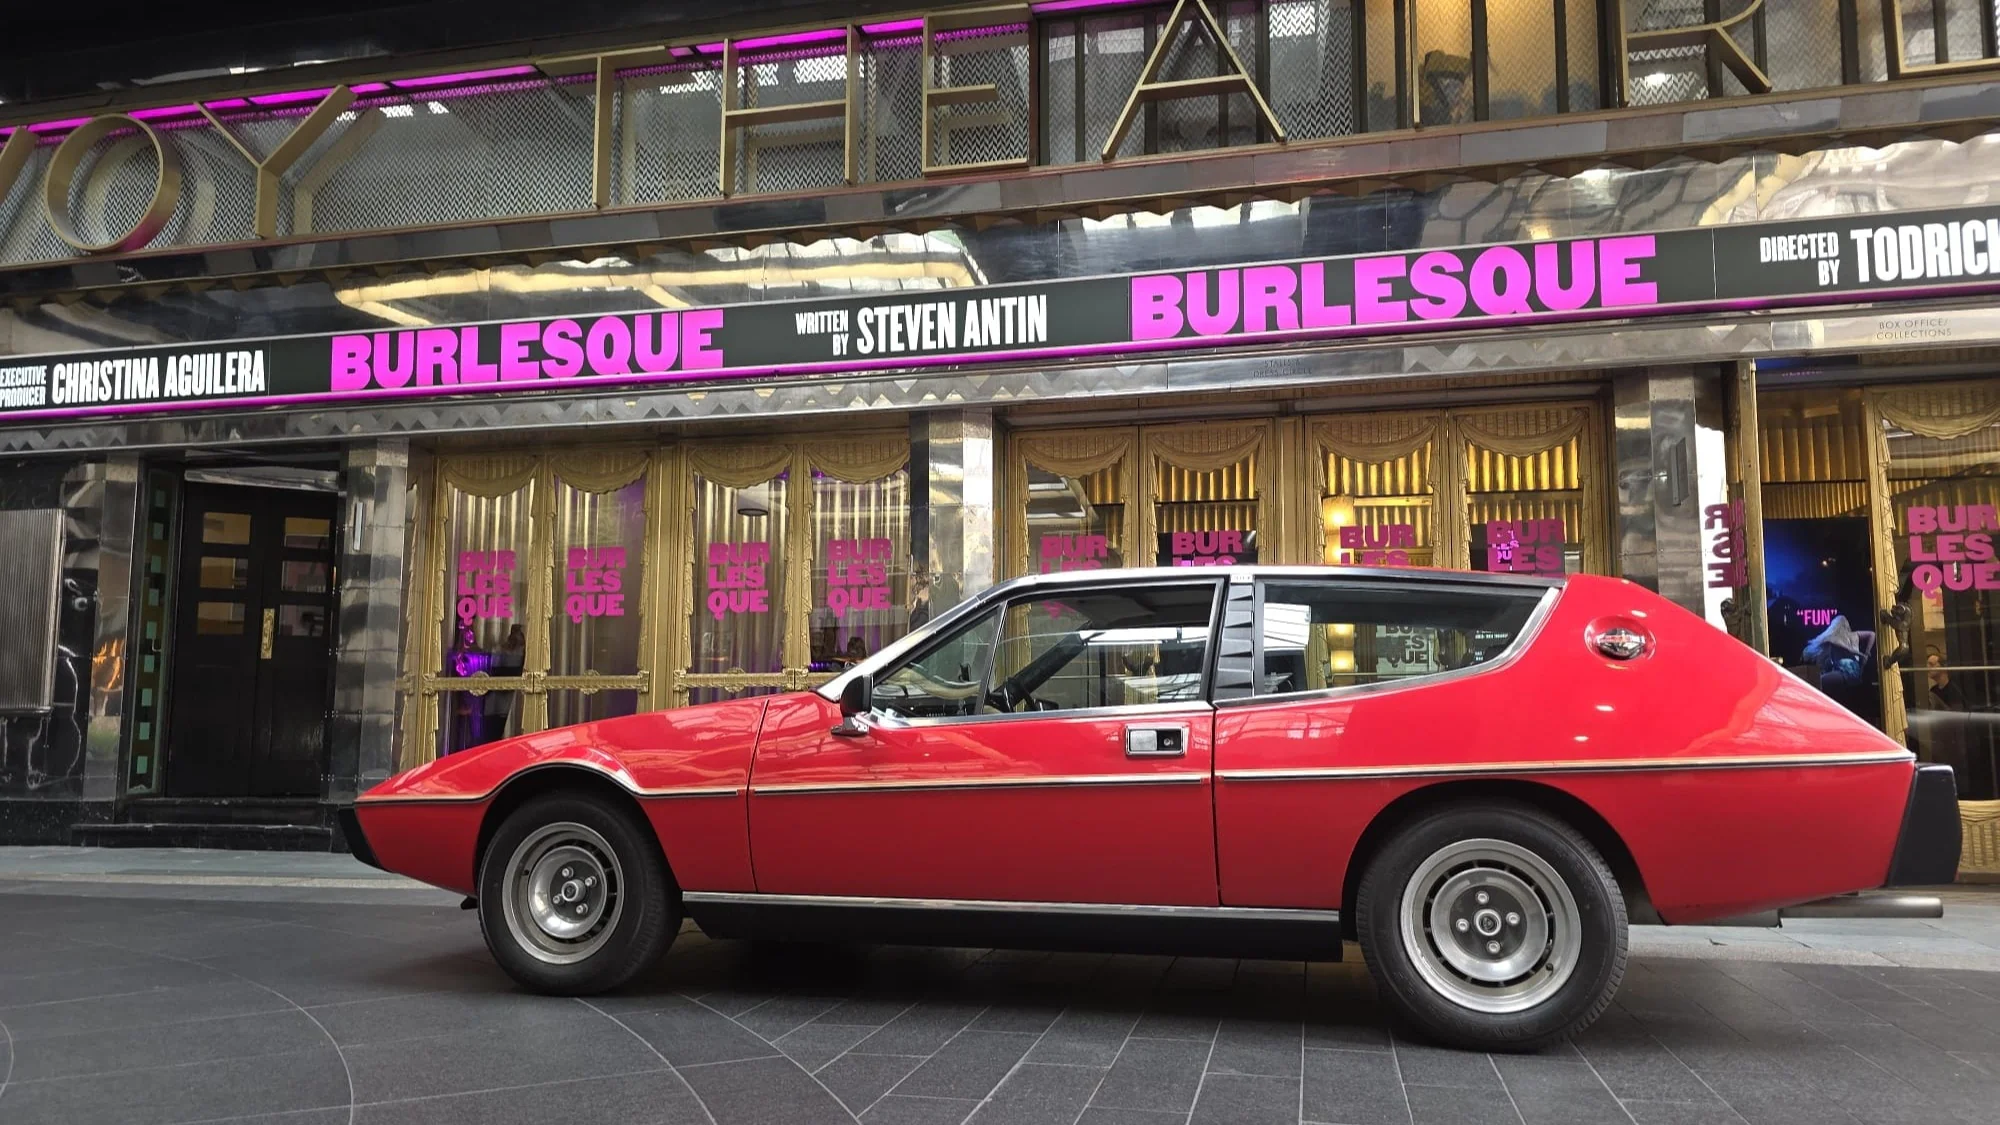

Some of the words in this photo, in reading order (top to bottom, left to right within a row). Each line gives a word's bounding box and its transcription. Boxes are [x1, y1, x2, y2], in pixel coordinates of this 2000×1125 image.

[1759, 232, 1839, 263] DIRECTED
[1818, 259, 1840, 286] BY
[1131, 234, 1658, 341] BURLESQUE
[795, 310, 849, 335] WRITTEN
[856, 301, 956, 354] STEVEN
[963, 294, 1047, 347] ANTIN
[1876, 328, 1952, 340] COLLECTIONS
[1879, 320, 1900, 330] BOX
[331, 308, 724, 392] BURLESQUE
[832, 333, 849, 356] BY
[0, 364, 47, 387] EXECUTIVE
[52, 356, 160, 404] CHRISTINA
[164, 350, 266, 397] AGUILERA
[0, 386, 46, 408] PRODUCER
[1907, 504, 2000, 533] BUR
[1172, 529, 1243, 555] BUR
[1340, 524, 1416, 549] BUR
[1487, 519, 1564, 544] BUR
[567, 546, 627, 569] BUR
[708, 542, 770, 565] BUR
[828, 538, 893, 561] BUR
[1041, 535, 1108, 559] BUR
[1487, 545, 1562, 572] LES
[1909, 533, 1995, 562] LES
[459, 550, 516, 572] BUR
[828, 561, 887, 586] LES
[457, 572, 511, 596] LES
[566, 570, 622, 593] LES
[707, 565, 766, 589] LES
[1911, 563, 2000, 599] QUE
[457, 597, 513, 626] QUE
[566, 594, 625, 624] QUE
[707, 590, 769, 621] QUE
[828, 587, 892, 618] QUE
